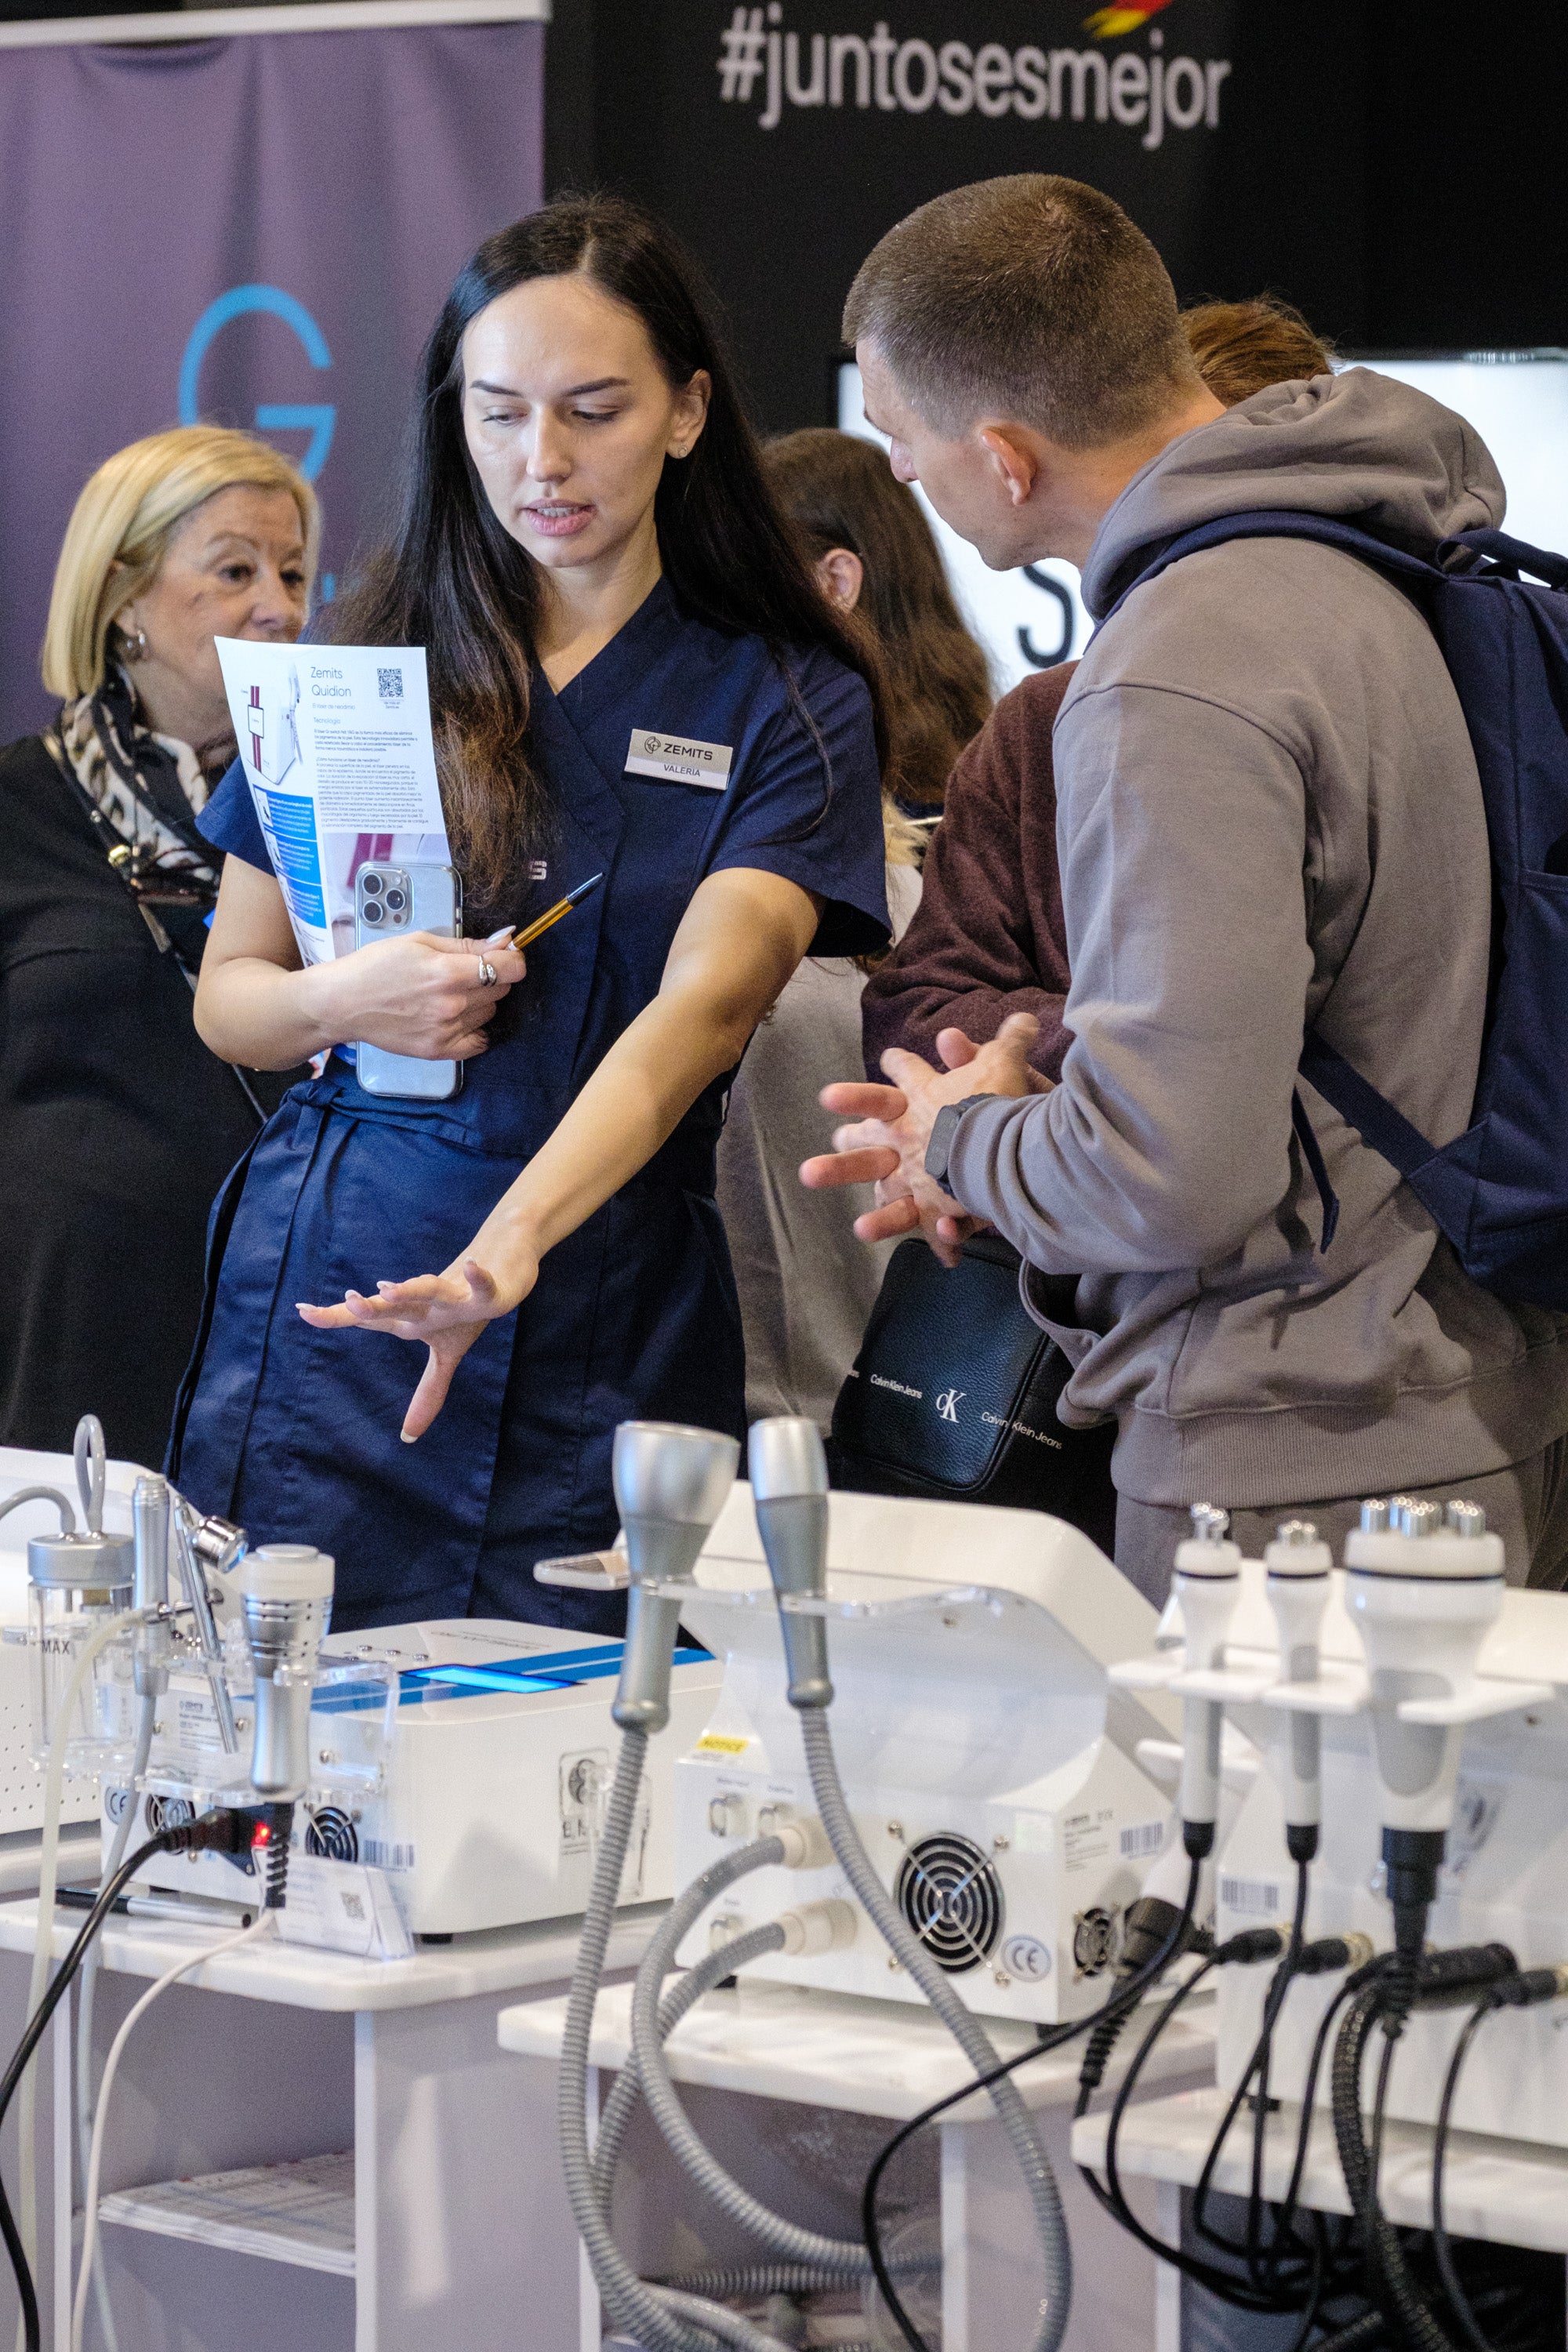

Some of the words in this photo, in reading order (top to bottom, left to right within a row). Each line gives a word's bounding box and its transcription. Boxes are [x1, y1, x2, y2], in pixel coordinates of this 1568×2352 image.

[717, 3, 1231, 151] #juntosesmejor
[310, 666, 343, 679] Zemits
[311, 684, 352, 697] Quidion
[663, 742, 713, 760] ZEMITS
[663, 764, 701, 777] VALERIA
[870, 1374, 890, 1386] Calvin
[890, 1380, 904, 1392] Klein
[903, 1385, 923, 1399] Jeans
[982, 1411, 1008, 1428] Calvin
[1012, 1420, 1034, 1438] Klein
[1035, 1431, 1062, 1450] Jeans
[42, 1639, 71, 1655] MAX
